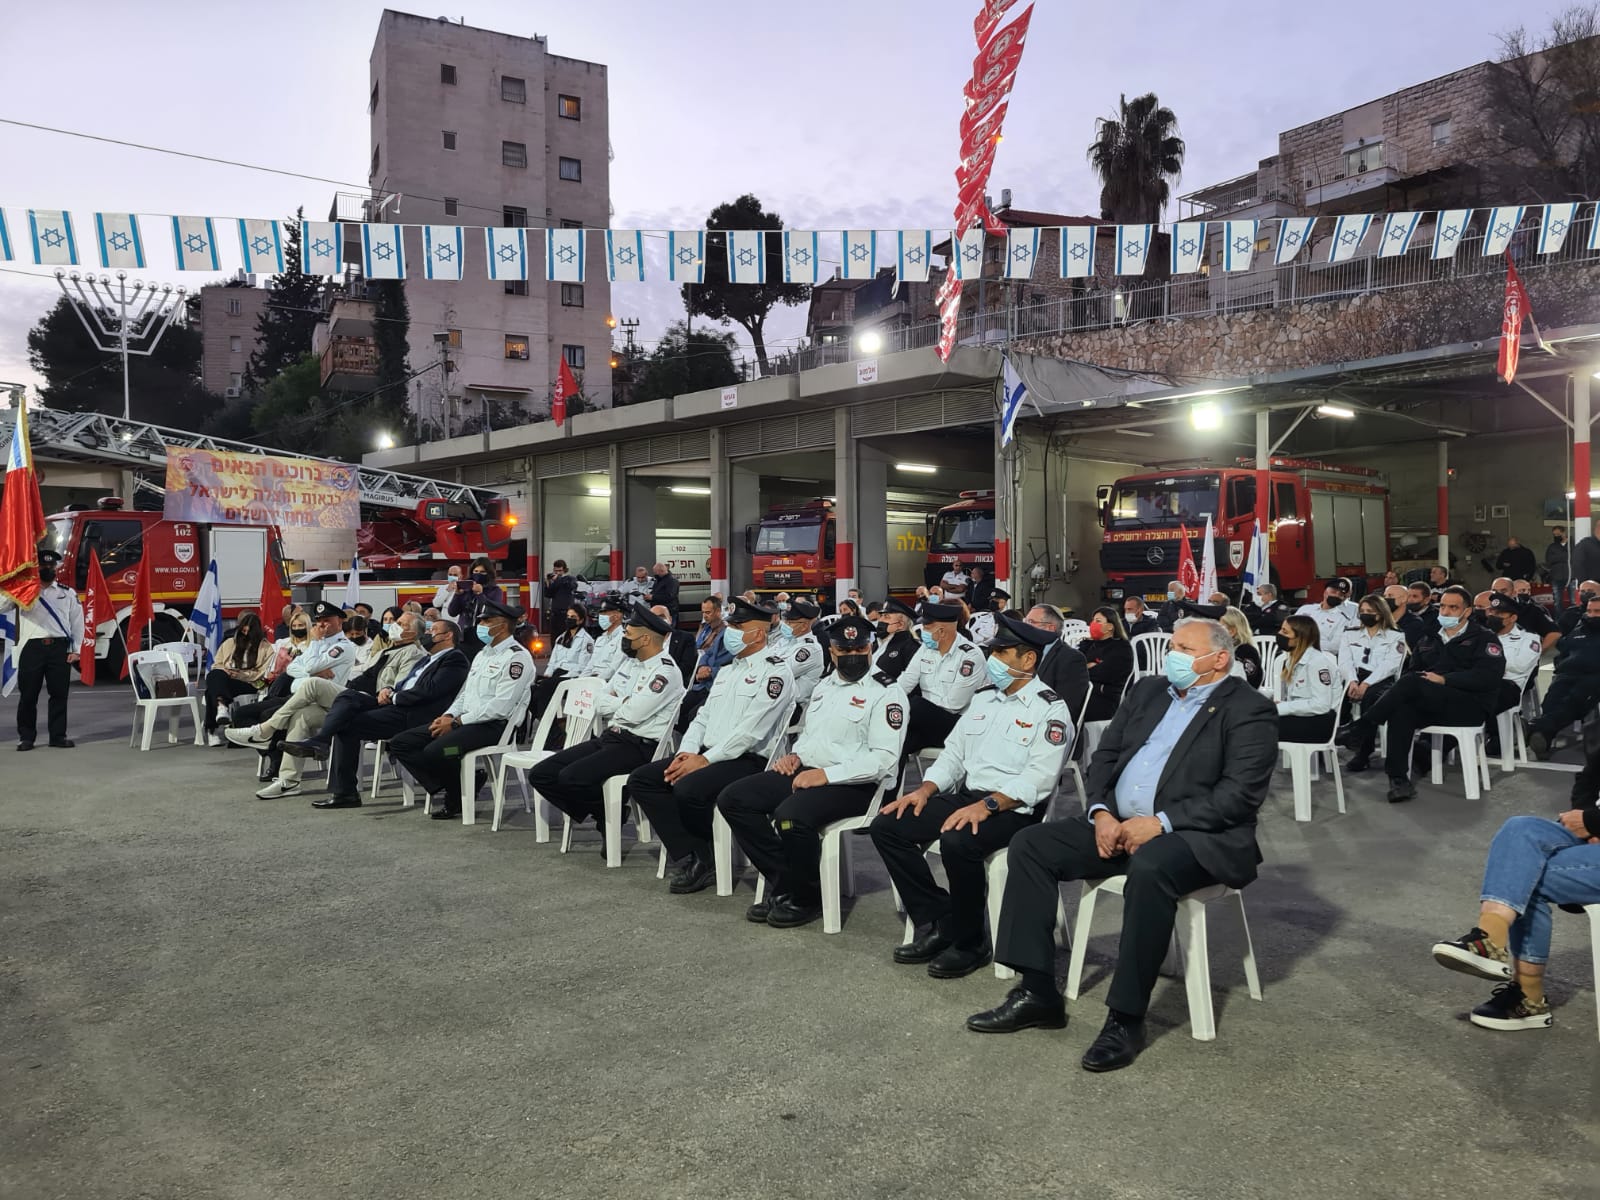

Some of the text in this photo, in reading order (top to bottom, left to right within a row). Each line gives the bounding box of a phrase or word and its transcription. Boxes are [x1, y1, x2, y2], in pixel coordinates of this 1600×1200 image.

[211, 457, 322, 481] ברוכים הבאים
[189, 481, 248, 500] לישראל
[363, 492, 394, 503] MAGIRUS
[175, 528, 192, 537] 102
[1113, 530, 1199, 542] כבות והצלה ירושלים
[896, 531, 926, 551] צלה
[974, 555, 994, 563] כבאות
